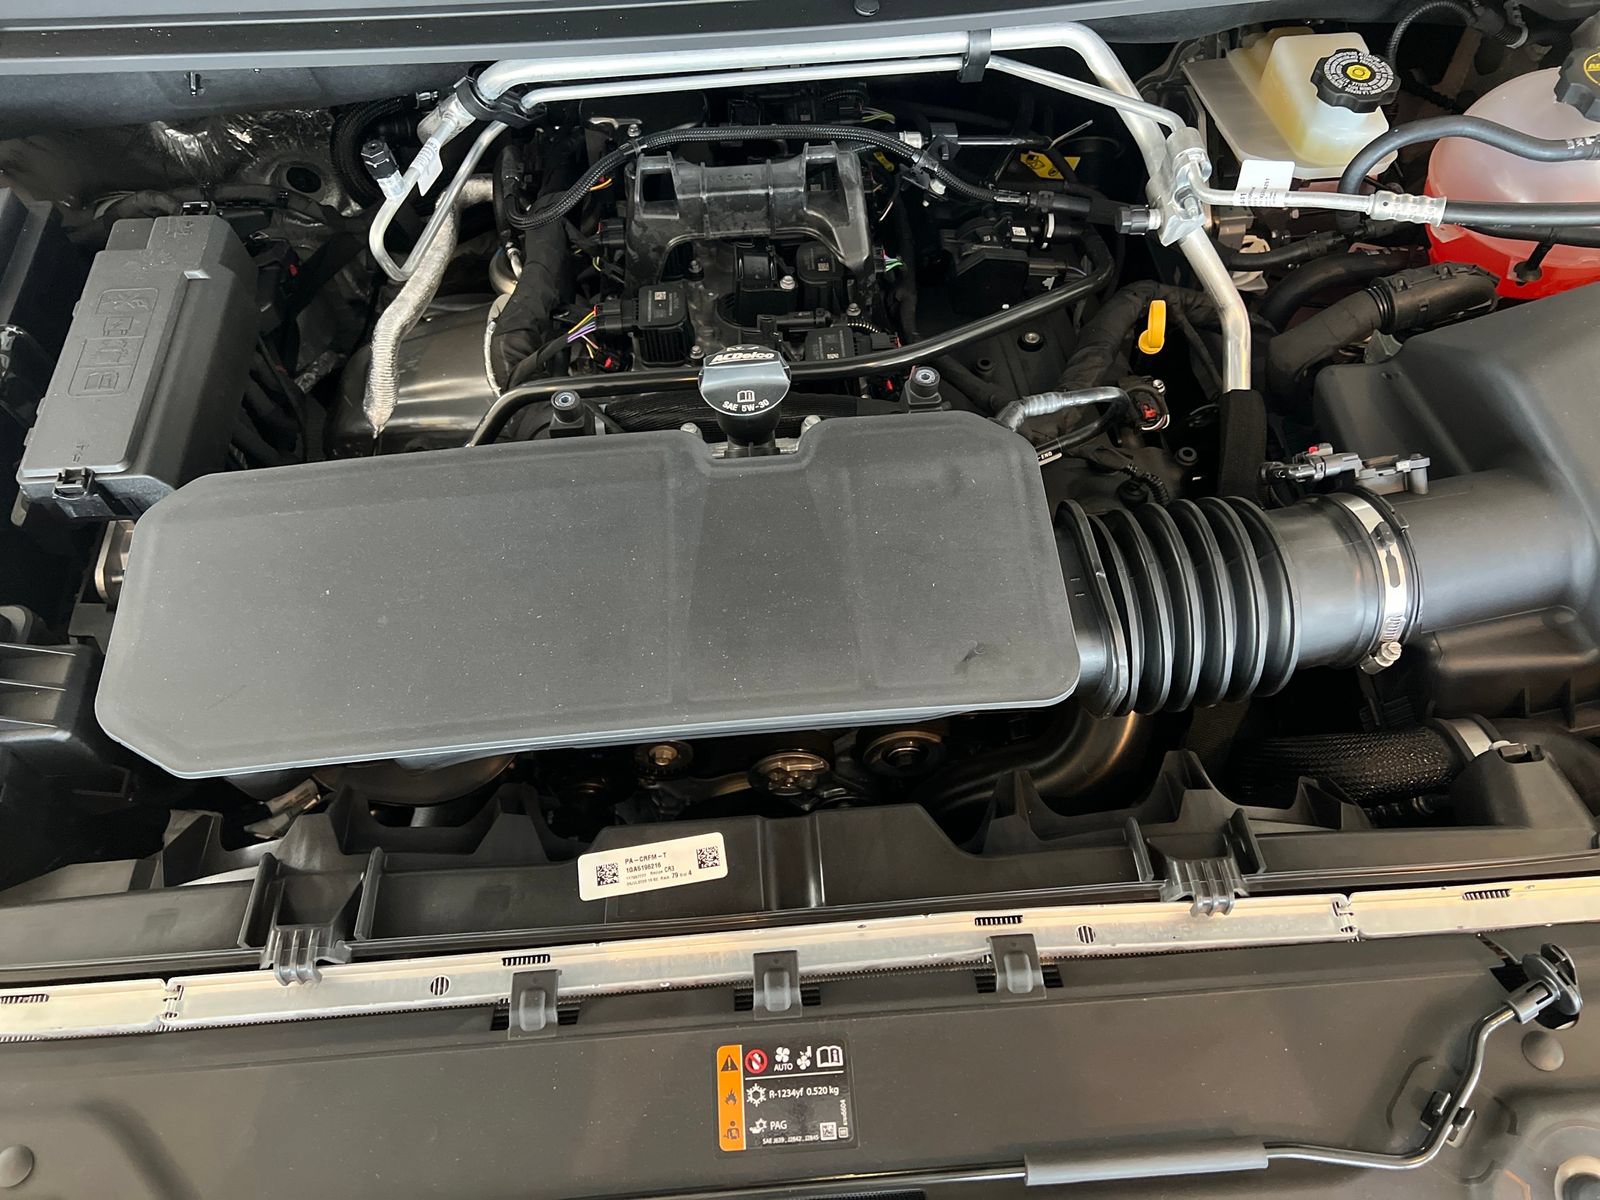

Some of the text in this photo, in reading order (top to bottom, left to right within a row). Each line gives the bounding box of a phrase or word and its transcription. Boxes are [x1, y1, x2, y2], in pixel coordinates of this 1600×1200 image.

[710, 352, 775, 364] ACDelco
[722, 399, 770, 412] SAE 5W-30
[774, 1063, 793, 1071] AUTO
[769, 1085, 840, 1099] R-1234yf 0.520 kg
[770, 1120, 788, 1131] PAG
